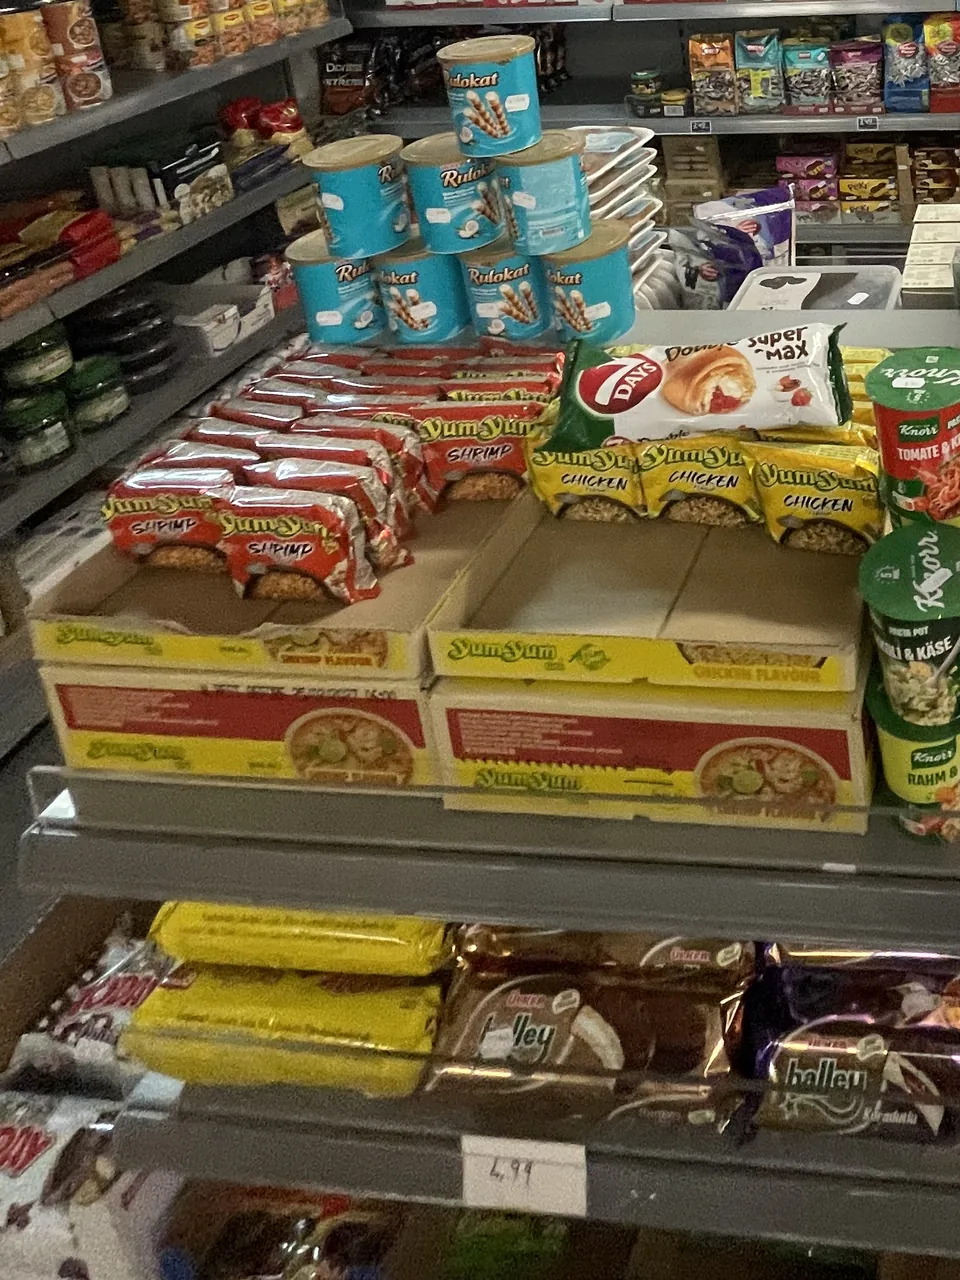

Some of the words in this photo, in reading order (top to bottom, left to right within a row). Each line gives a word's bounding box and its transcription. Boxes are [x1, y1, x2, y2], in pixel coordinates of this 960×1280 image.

[380, 270, 419, 285] lokat
[468, 263, 530, 285] Rulokat
[547, 269, 583, 285] lokat
[595, 357, 638, 406] 7
[614, 362, 658, 401] DAYS
[898, 422, 939, 437] Knorr
[447, 444, 512, 463] SHRIMP
[639, 444, 745, 472] YumYu
[897, 445, 940, 462] TOMATE
[560, 472, 629, 491] CHICKEN
[668, 470, 739, 489] CHICKEN
[783, 493, 854, 513] CHICKEN
[131, 516, 198, 535] SHRIMP
[248, 542, 313, 558] SHRIMP
[912, 530, 946, 613] Korr
[916, 635, 954, 661] KÄSE
[912, 746, 955, 763] Knorr
[908, 768, 946, 787] RAHM
[785, 1056, 867, 1100] halley
